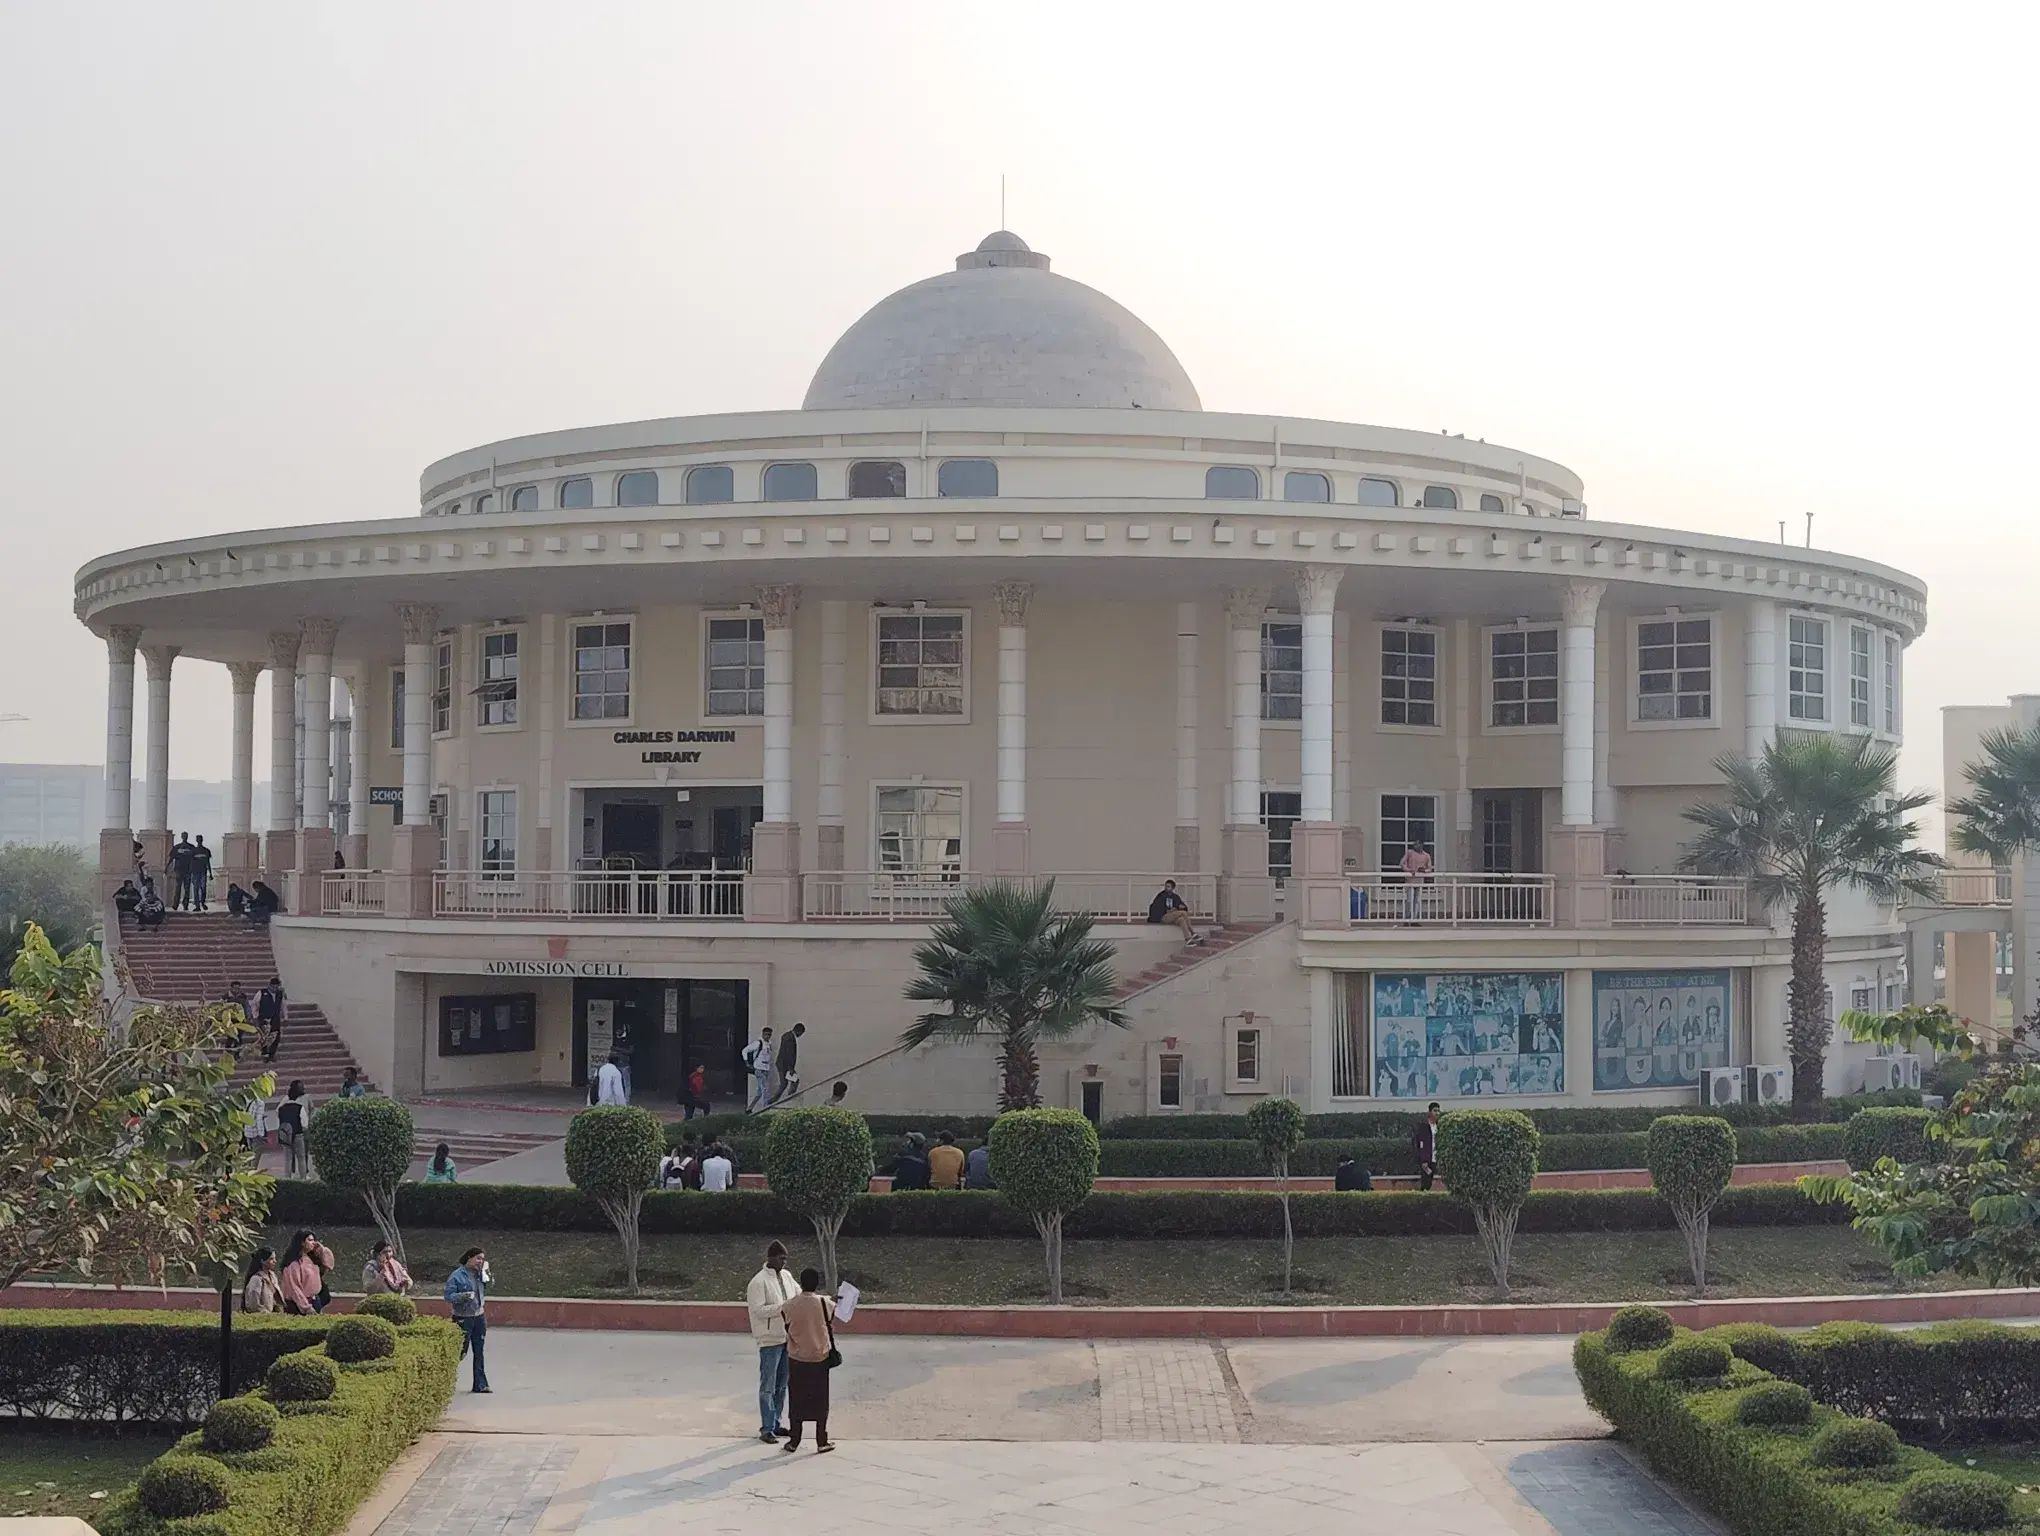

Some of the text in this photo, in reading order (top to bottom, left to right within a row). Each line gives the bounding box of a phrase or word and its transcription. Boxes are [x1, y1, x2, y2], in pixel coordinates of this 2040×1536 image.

[613, 730, 736, 743] CHARLES DARWIN
[641, 751, 701, 763] LIBRARY
[371, 790, 404, 801] SCHOO
[484, 961, 629, 976] ADMISSION CELL
[1646, 976, 1669, 988] BEST
[1687, 975, 1700, 986] AT
